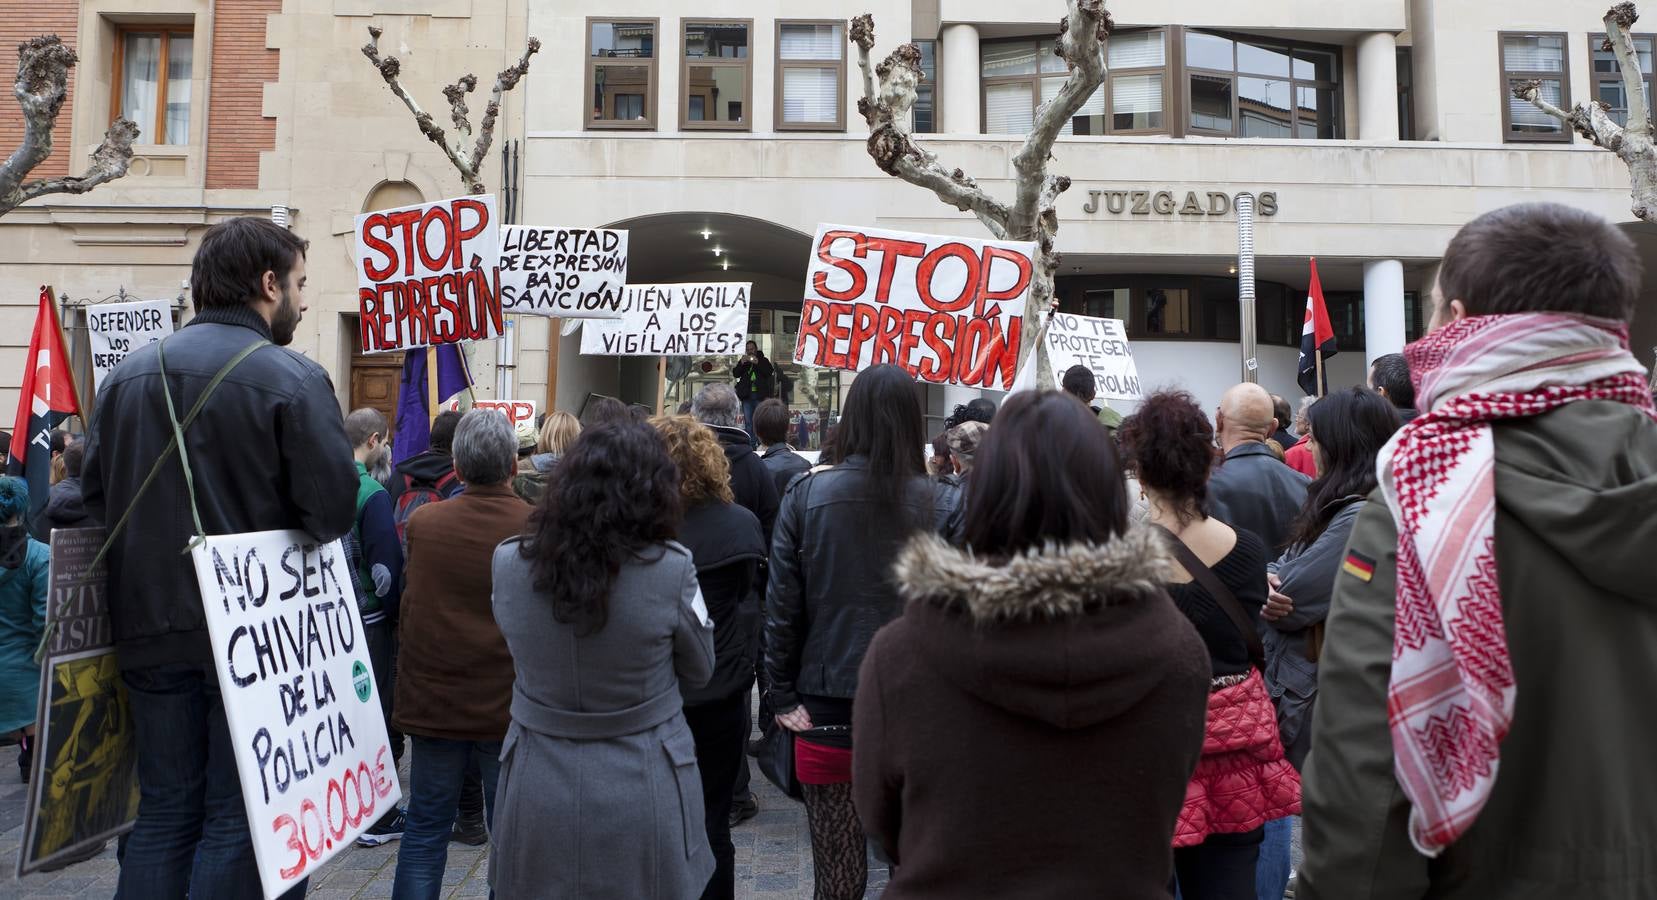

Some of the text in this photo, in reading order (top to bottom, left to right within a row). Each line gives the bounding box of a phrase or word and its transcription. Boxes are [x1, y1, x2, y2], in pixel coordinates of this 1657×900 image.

[362, 199, 489, 281] STOP
[503, 228, 619, 252] LIBERTAD
[500, 248, 627, 273] DE EXPRESIÓN
[813, 230, 1034, 317] STOP
[526, 271, 580, 291] BAJO
[359, 253, 504, 351] REPRESIÓN
[501, 280, 623, 312] SANCIÓN
[681, 286, 748, 309] VIGILA
[90, 309, 163, 333] DEFENDER
[645, 312, 717, 333] A LOS
[1051, 314, 1117, 336] NO TE
[107, 336, 130, 352] LOS
[796, 301, 1023, 391] REPRESIÓN
[1049, 332, 1132, 357] PROTEGEN
[1072, 353, 1105, 371] TE
[212, 543, 342, 615] NO SER
[227, 598, 354, 688] CHIVATO
[279, 674, 308, 727] DE
[312, 670, 336, 710] LA
[252, 711, 355, 805] POLICIA
[272, 744, 393, 880] 30.000€
